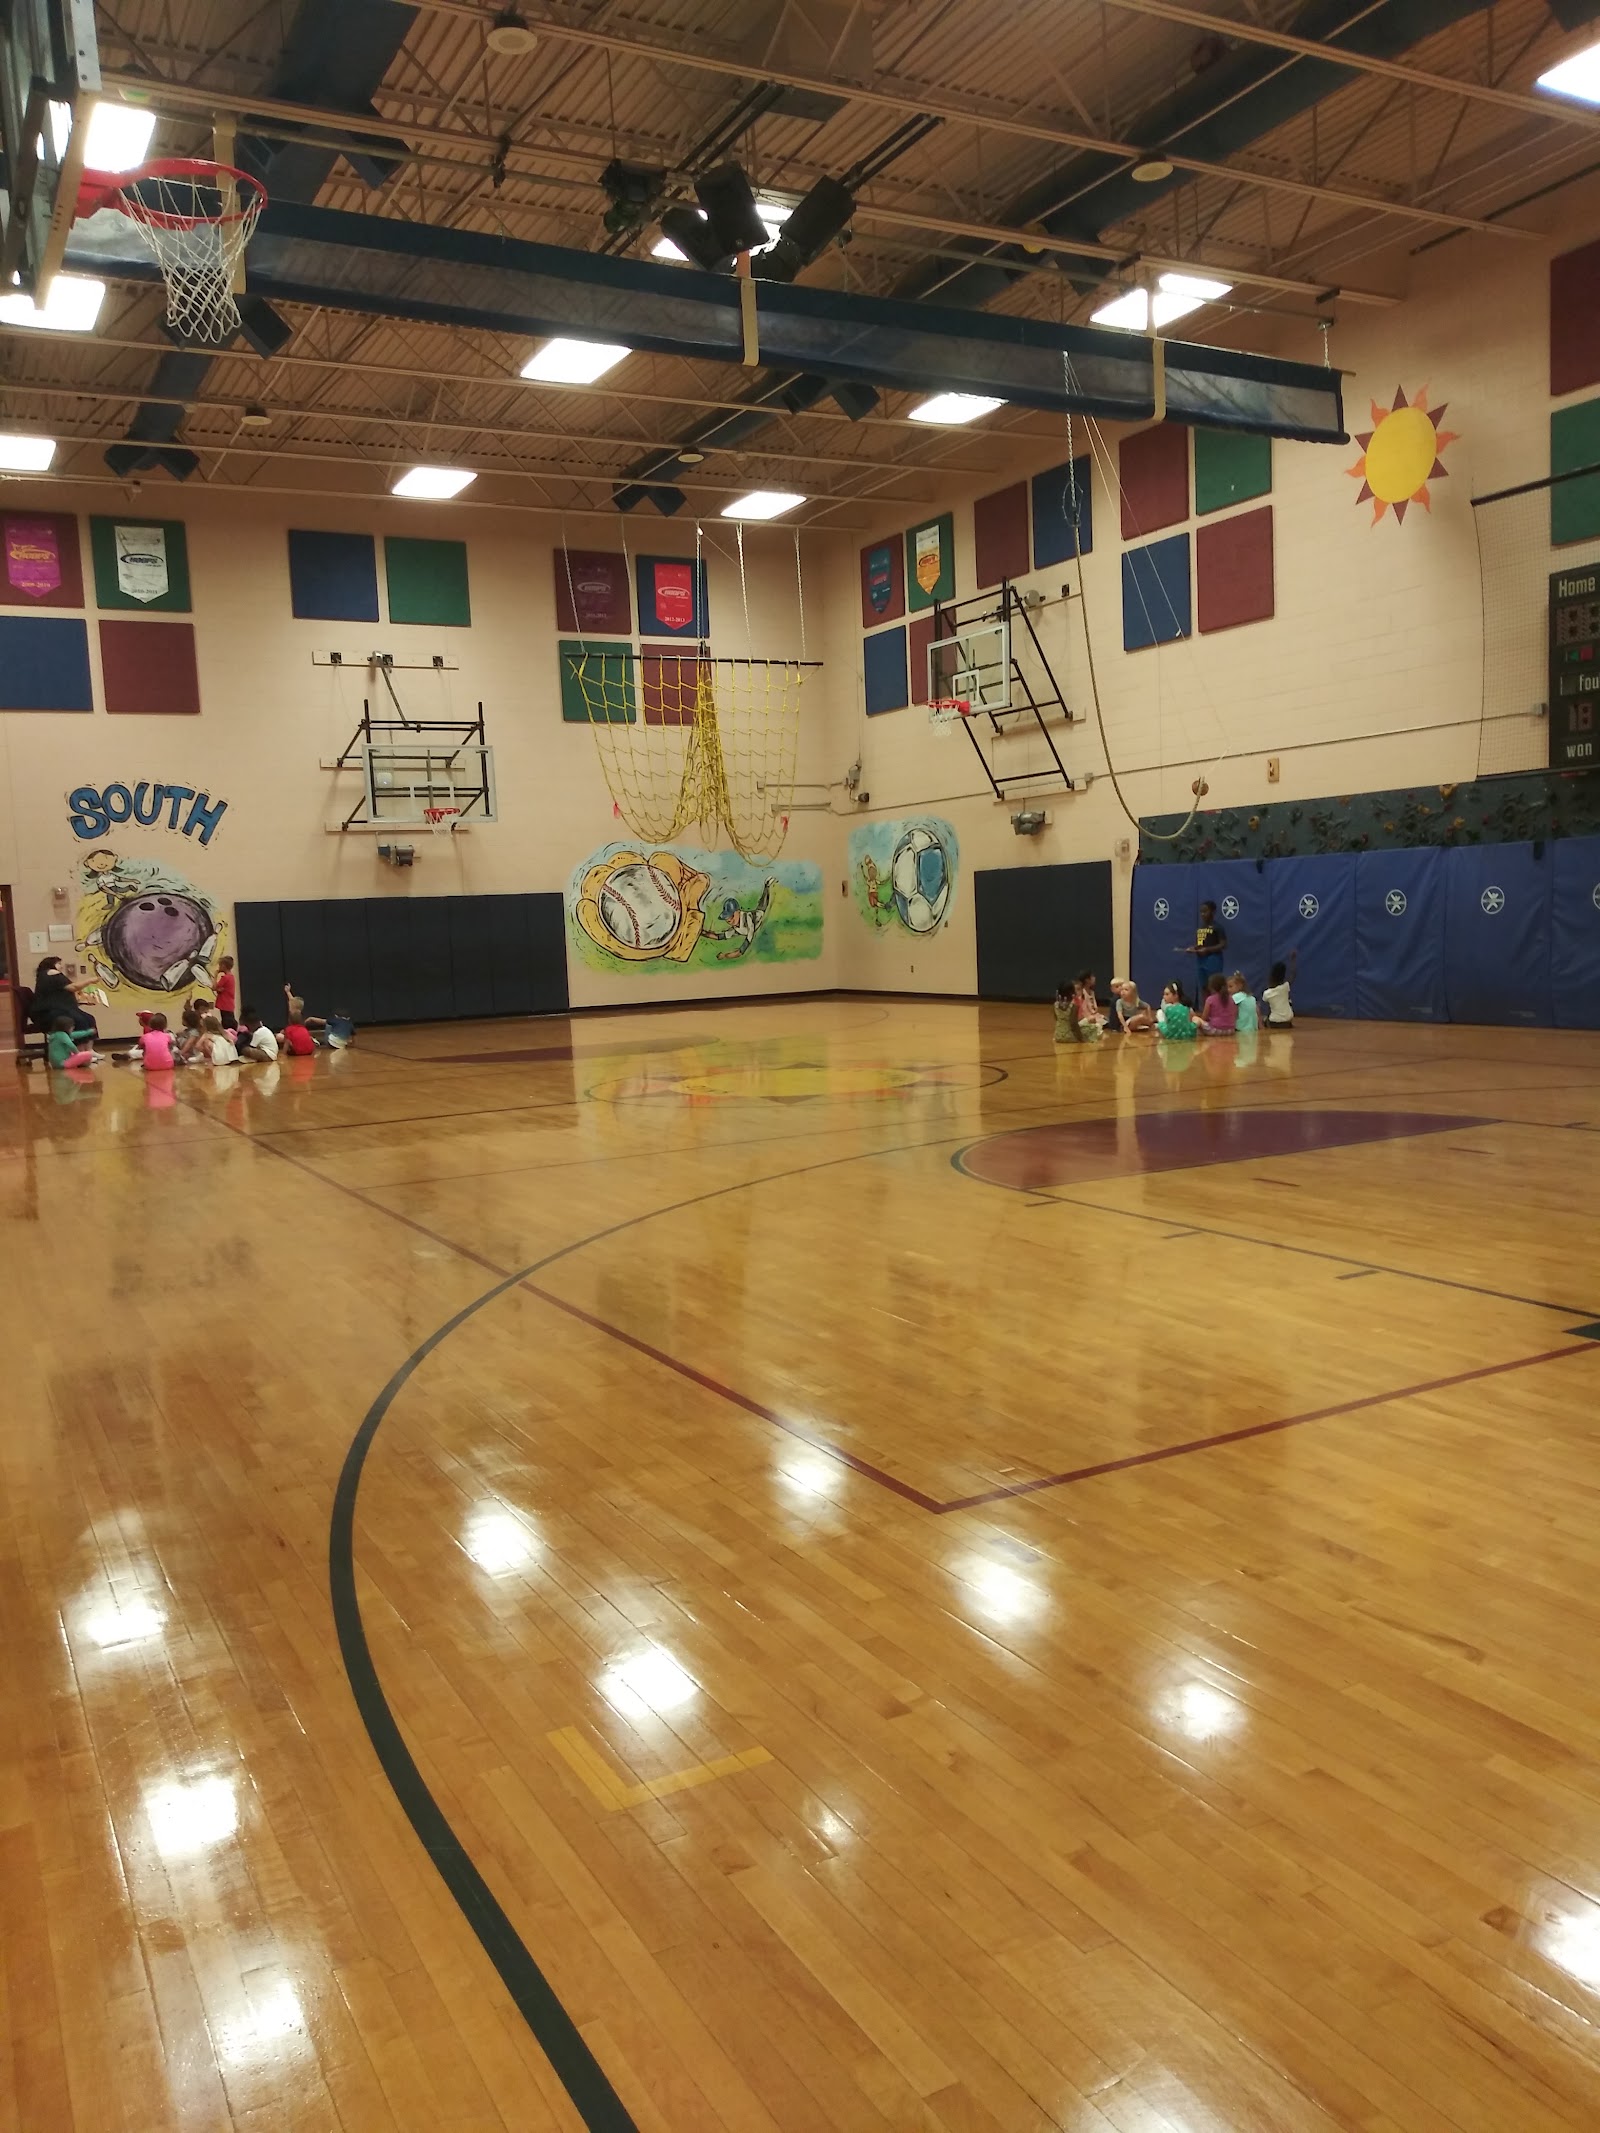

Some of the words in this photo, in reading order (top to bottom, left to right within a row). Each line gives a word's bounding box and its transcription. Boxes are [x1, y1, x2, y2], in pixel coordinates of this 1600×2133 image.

[1559, 576, 1596, 598] Home
[1566, 743, 1593, 758] won
[68, 781, 229, 846] SOUTH
